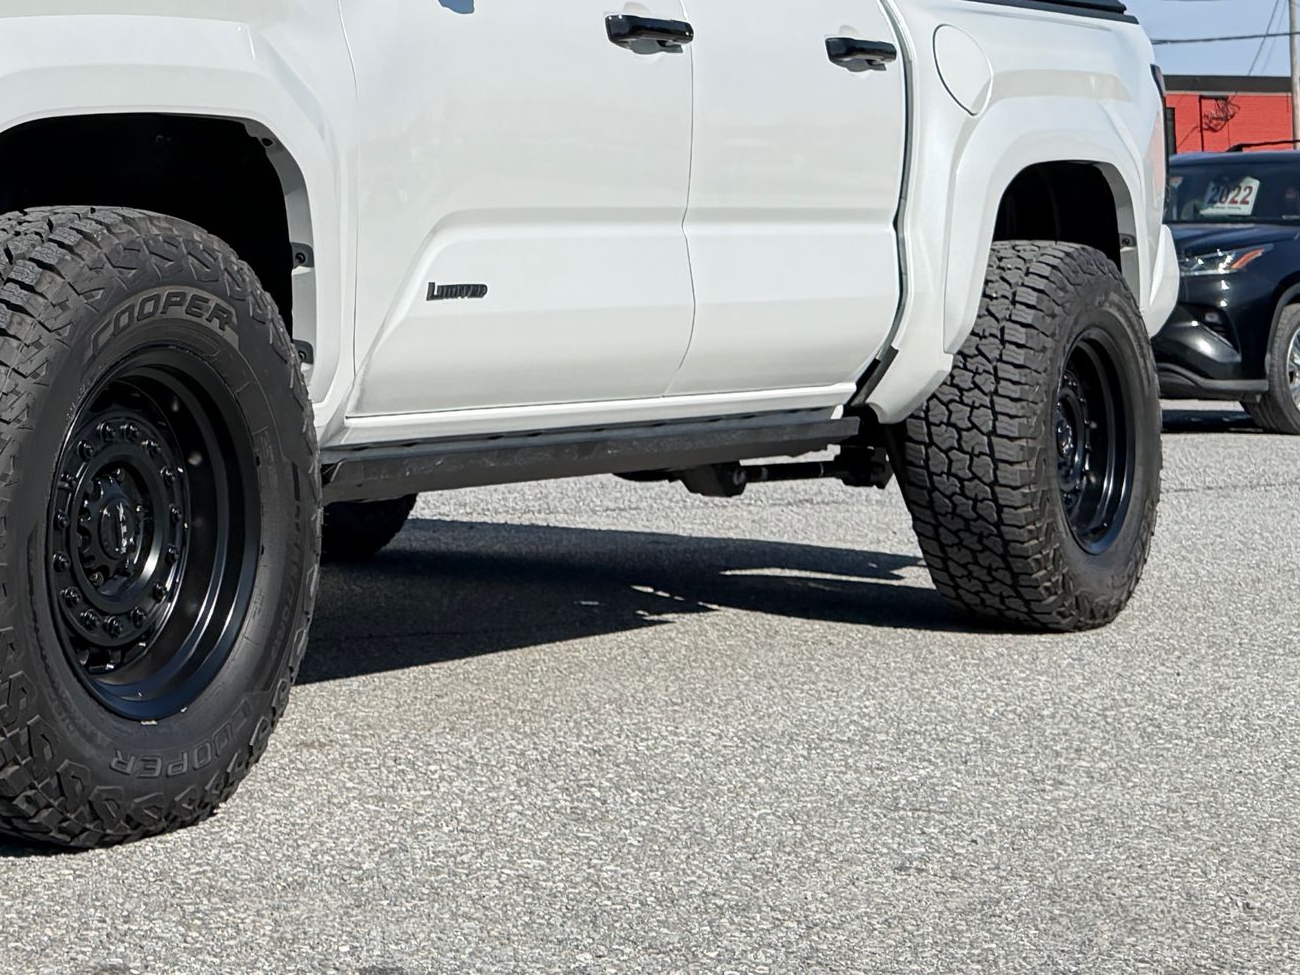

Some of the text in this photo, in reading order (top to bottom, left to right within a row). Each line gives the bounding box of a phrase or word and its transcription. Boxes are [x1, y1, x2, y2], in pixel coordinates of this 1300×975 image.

[1208, 185, 1254, 205] 2022
[90, 290, 235, 356] COOPER
[109, 696, 252, 779] COOPER
